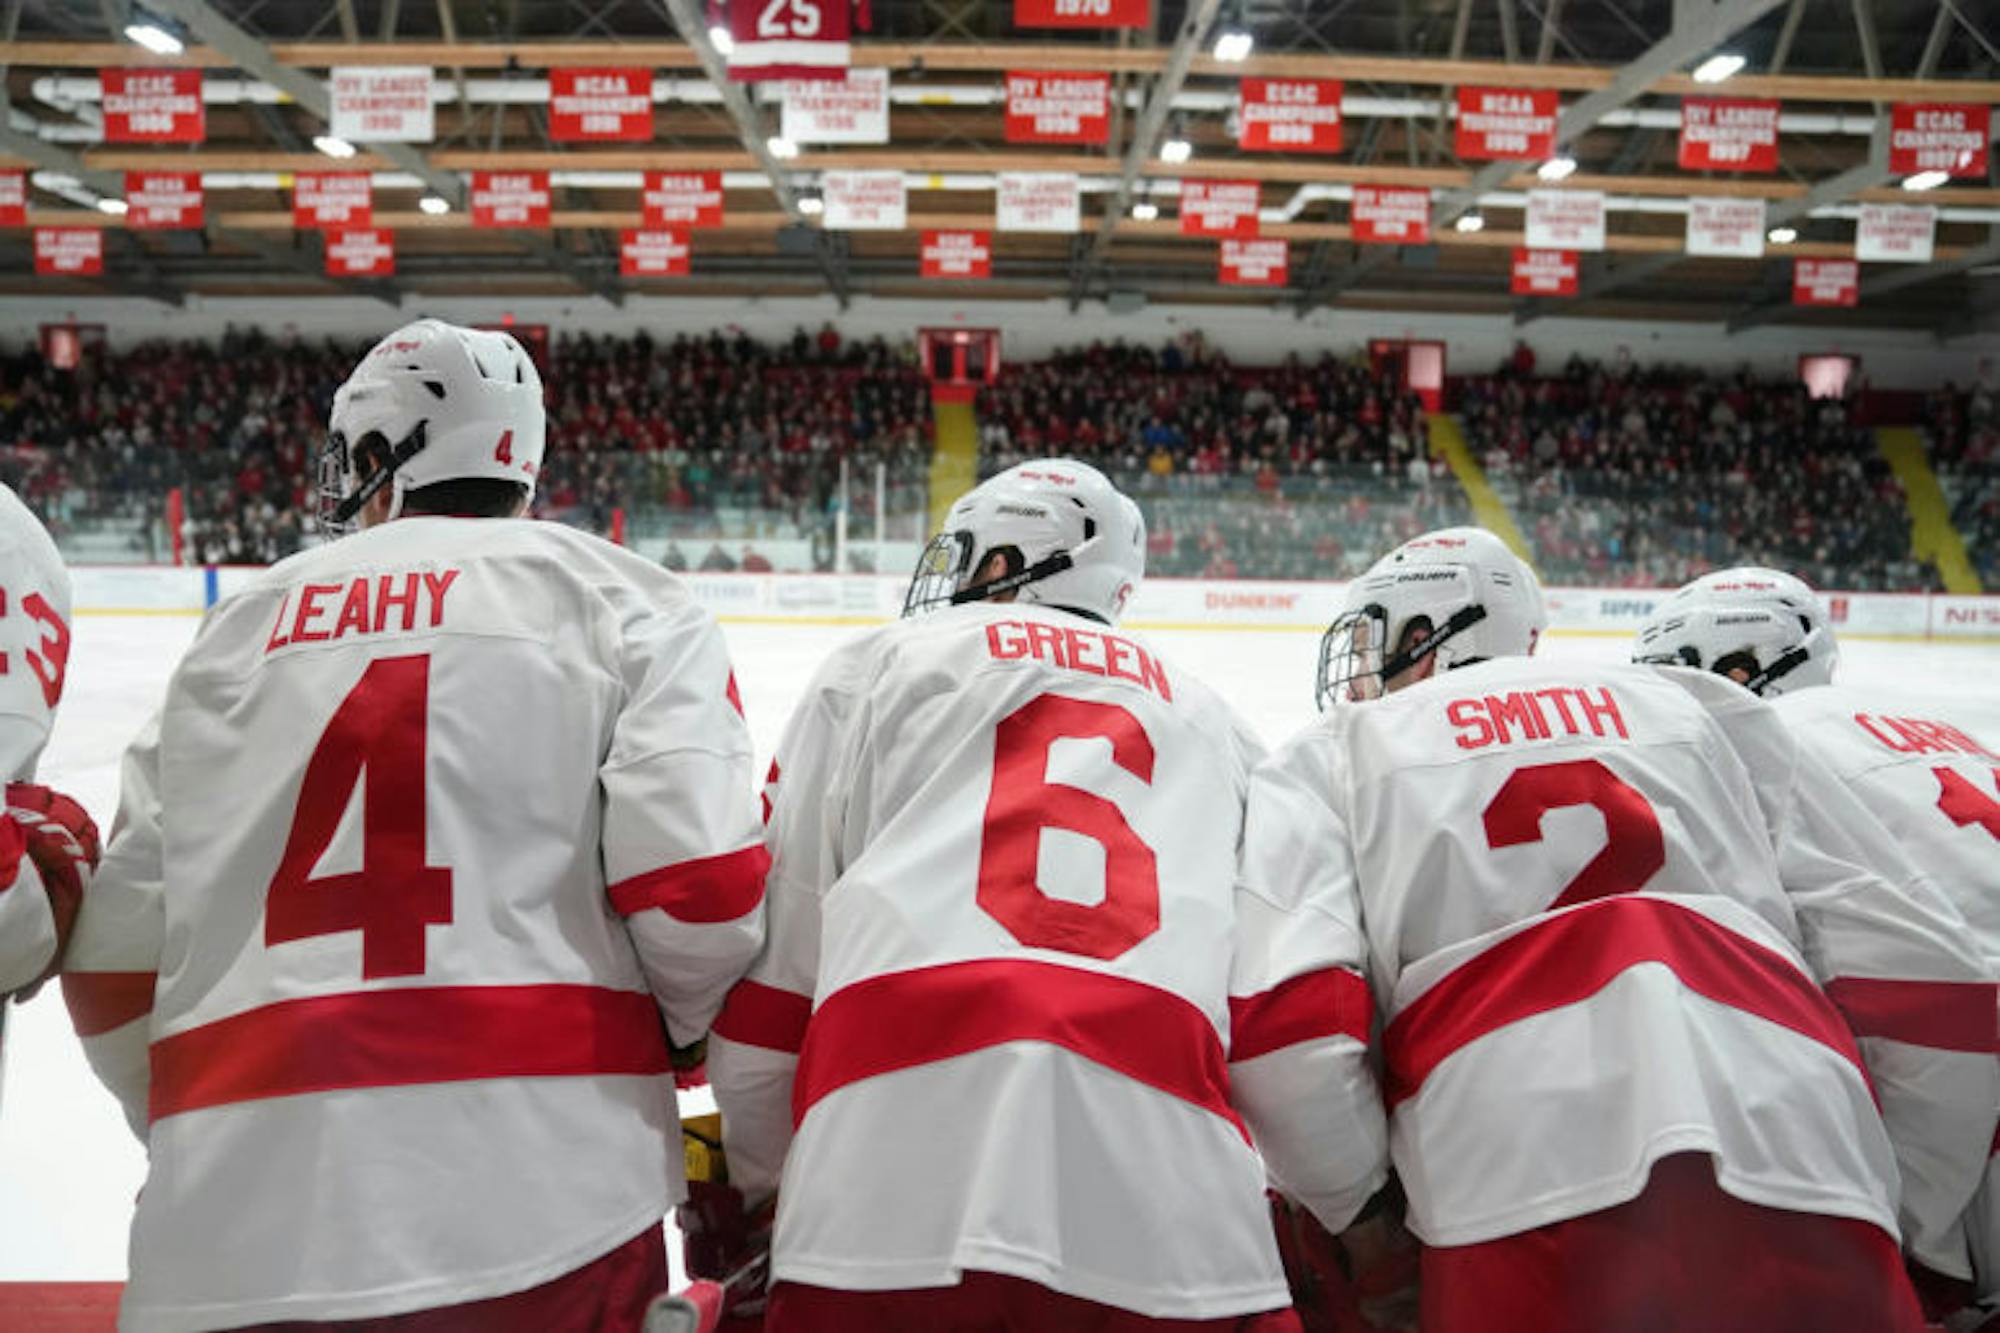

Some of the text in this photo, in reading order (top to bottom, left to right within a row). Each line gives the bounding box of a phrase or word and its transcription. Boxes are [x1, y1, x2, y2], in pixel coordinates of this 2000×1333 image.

[758, 0, 821, 37] 25
[495, 430, 513, 466] 4
[265, 570, 460, 655] LEAHY
[985, 621, 1172, 704] GREEN
[1447, 687, 1629, 750] SMITH
[265, 655, 453, 980] 4
[976, 693, 1162, 961] 6
[1482, 758, 1665, 912] 2
